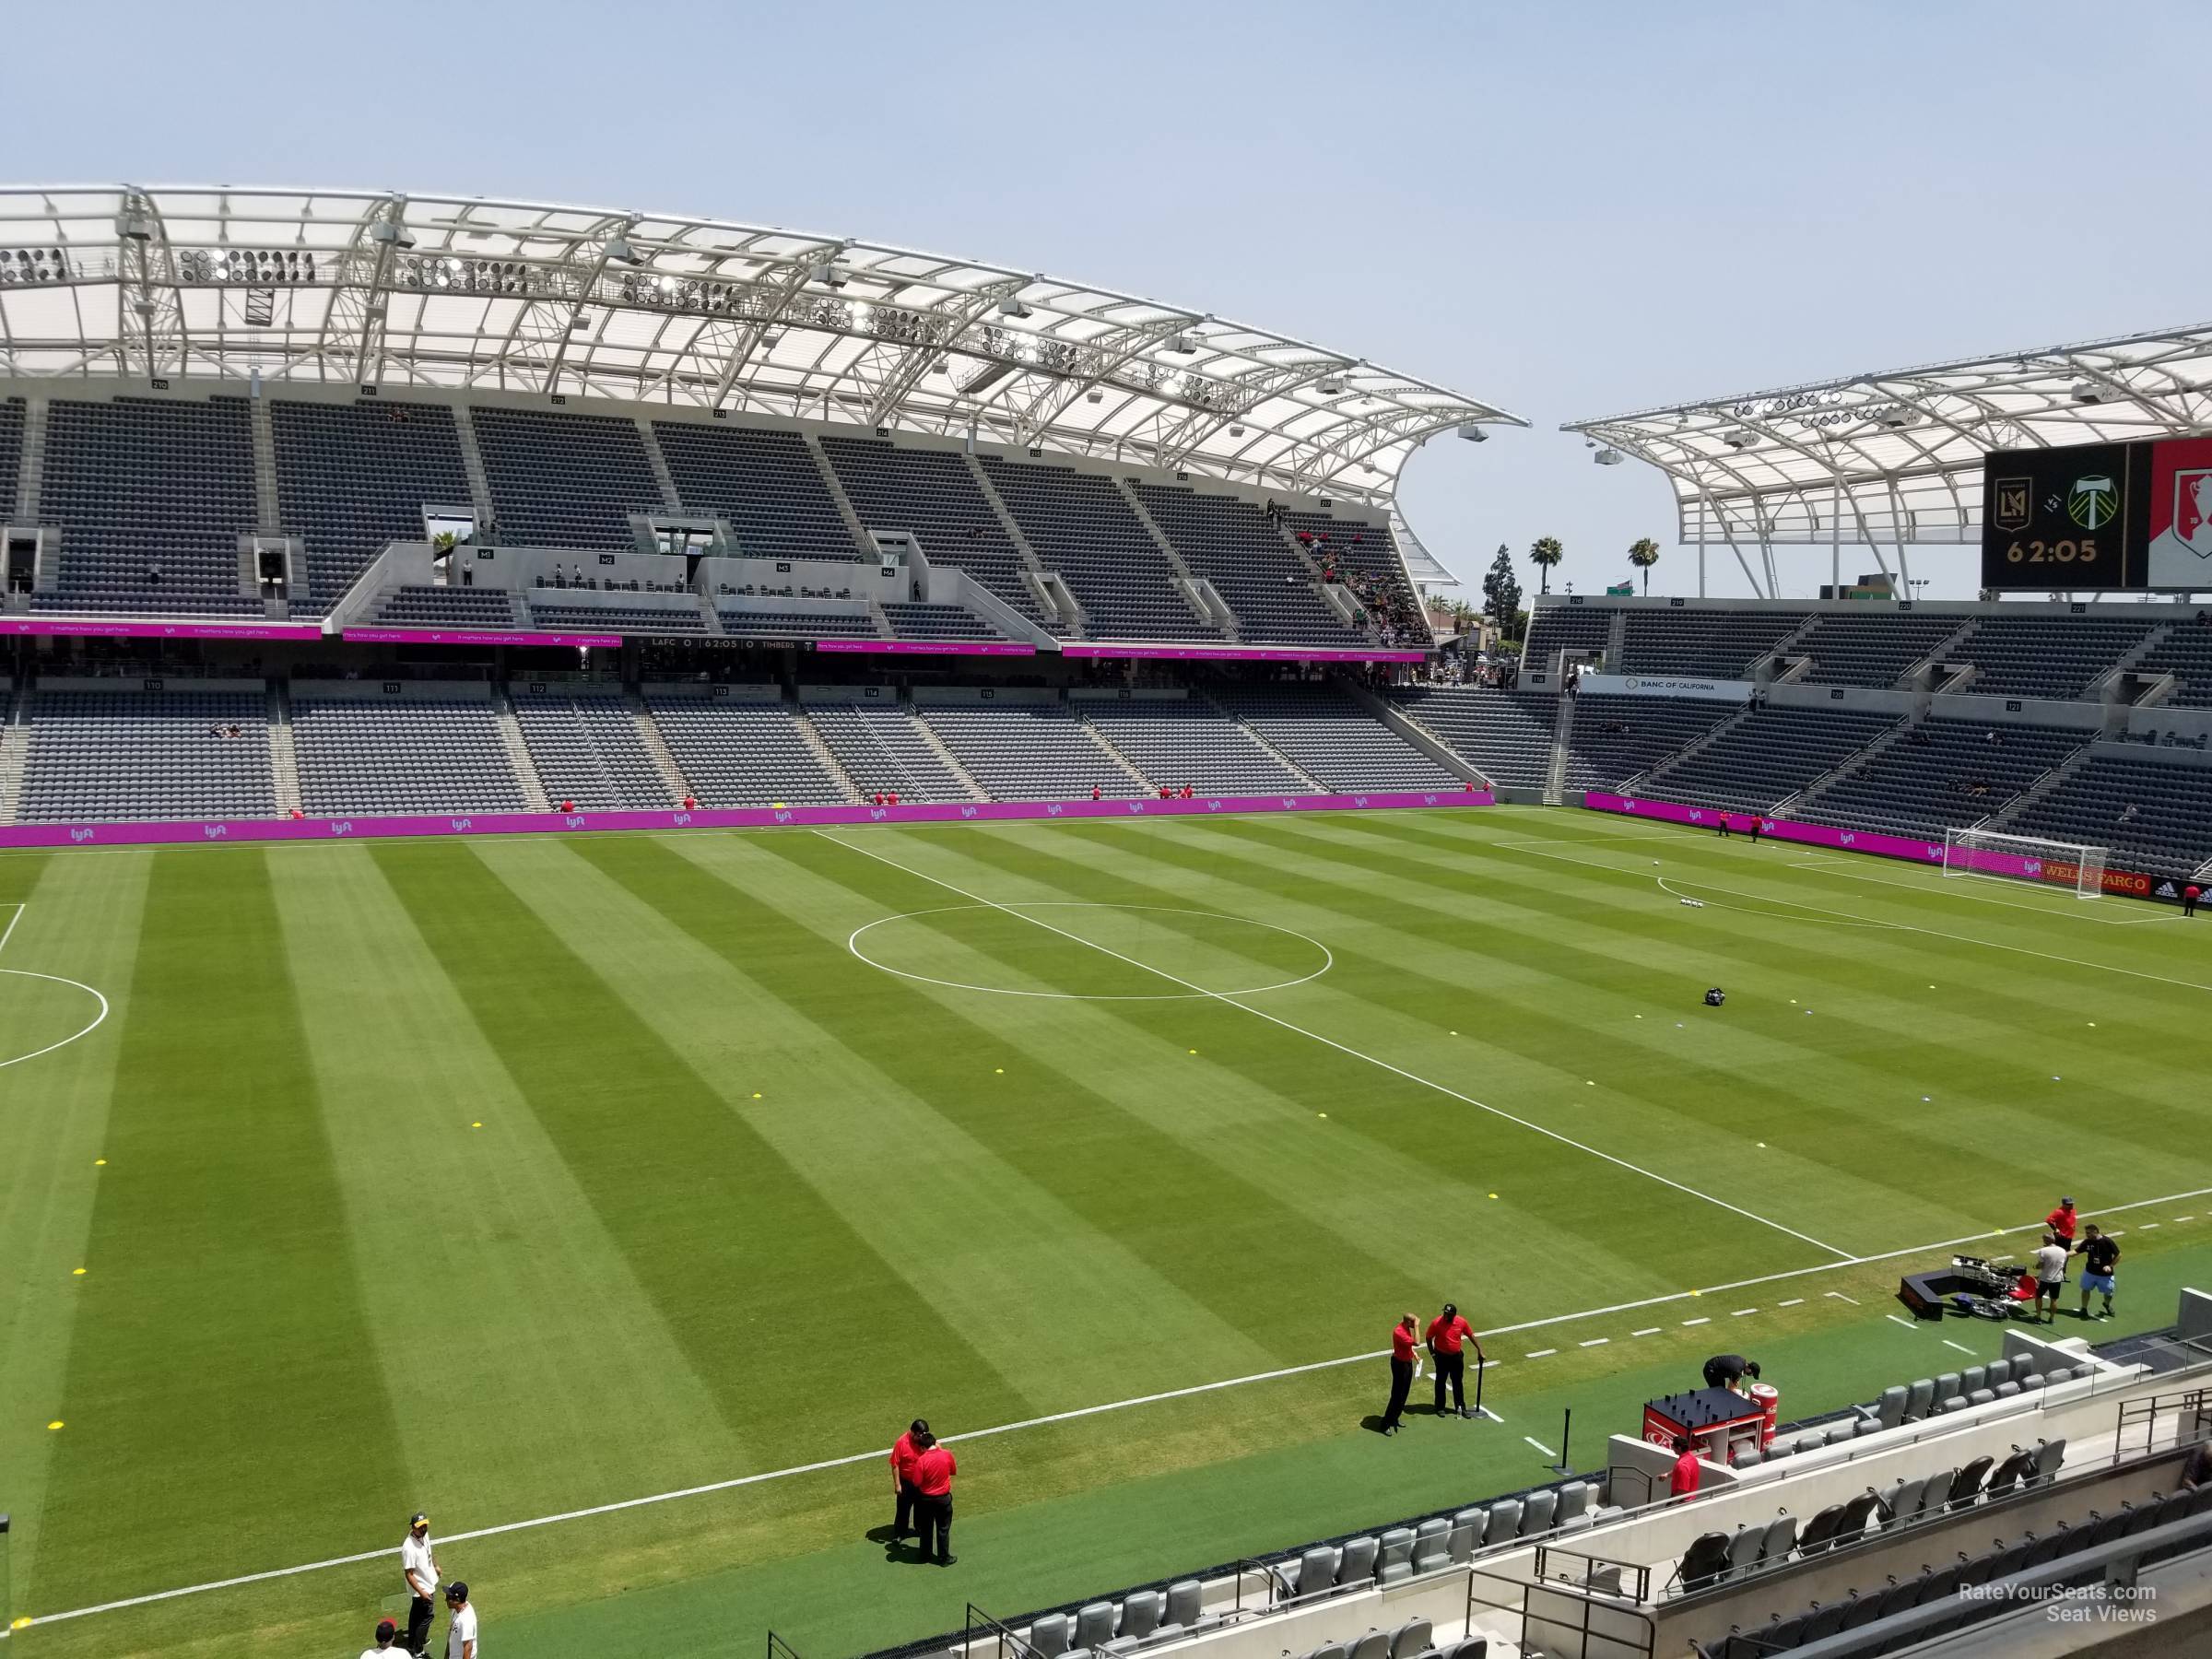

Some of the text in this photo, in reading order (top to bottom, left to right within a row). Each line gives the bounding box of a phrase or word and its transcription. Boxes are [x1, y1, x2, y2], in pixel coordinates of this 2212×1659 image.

[2007, 540, 2097, 562] 62:05
[704, 640, 737, 648] 62:05
[716, 688, 727, 696] 113
[1832, 690, 1843, 699] 120
[870, 807, 887, 819] lyft
[961, 806, 977, 818] lyft
[1047, 804, 1063, 815] lyft
[1129, 802, 1144, 813] lyft
[566, 816, 585, 828] lyft
[674, 813, 691, 825] lyft
[775, 810, 793, 822] lyft
[331, 821, 352, 834] lyft
[452, 818, 472, 831] lyft
[71, 828, 94, 841] lyft
[205, 825, 227, 838] lyft
[2099, 873, 2146, 889] FARGO
